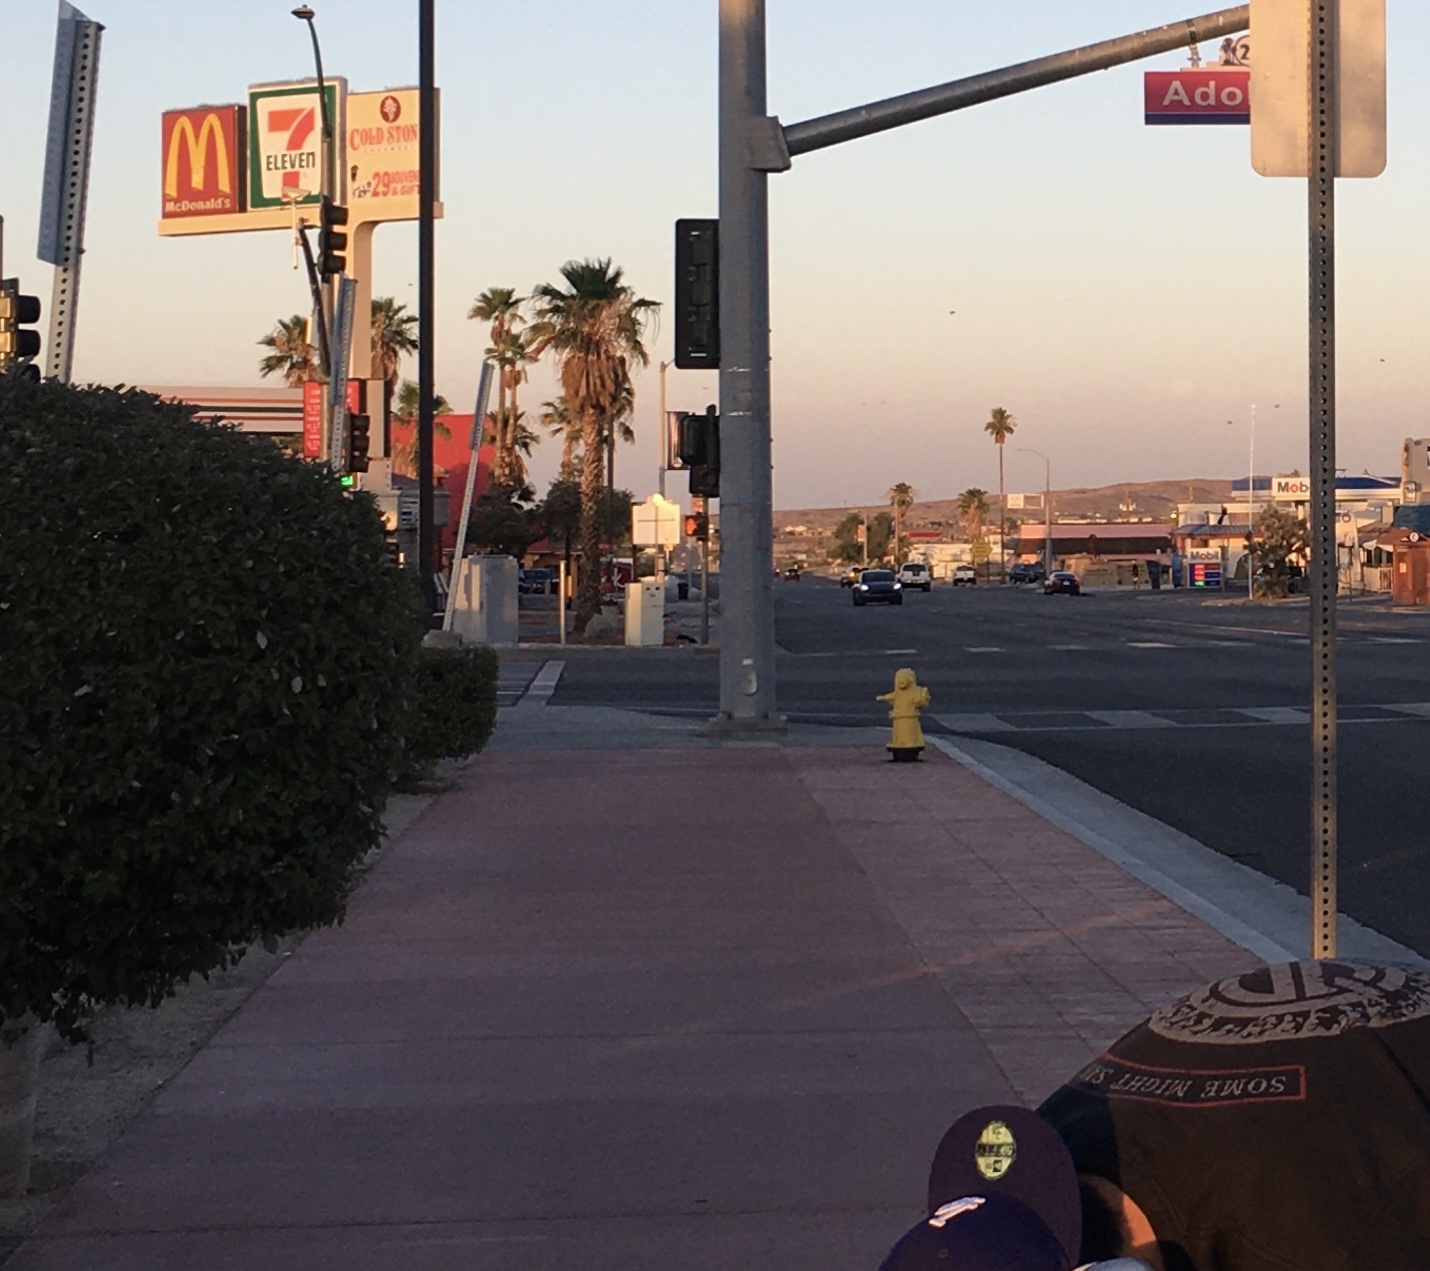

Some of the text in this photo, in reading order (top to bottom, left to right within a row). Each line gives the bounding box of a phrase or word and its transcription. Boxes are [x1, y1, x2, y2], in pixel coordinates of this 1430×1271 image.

[1162, 80, 1250, 106] Ado
[349, 124, 419, 151] COLD STON
[371, 170, 391, 198] 29
[165, 197, 231, 213] McDonald's
[1277, 481, 1309, 493] Mob
[1191, 551, 1219, 561] Mobil
[1110, 1072, 1194, 1098] MIGHT
[1201, 1076, 1287, 1099] SOME
